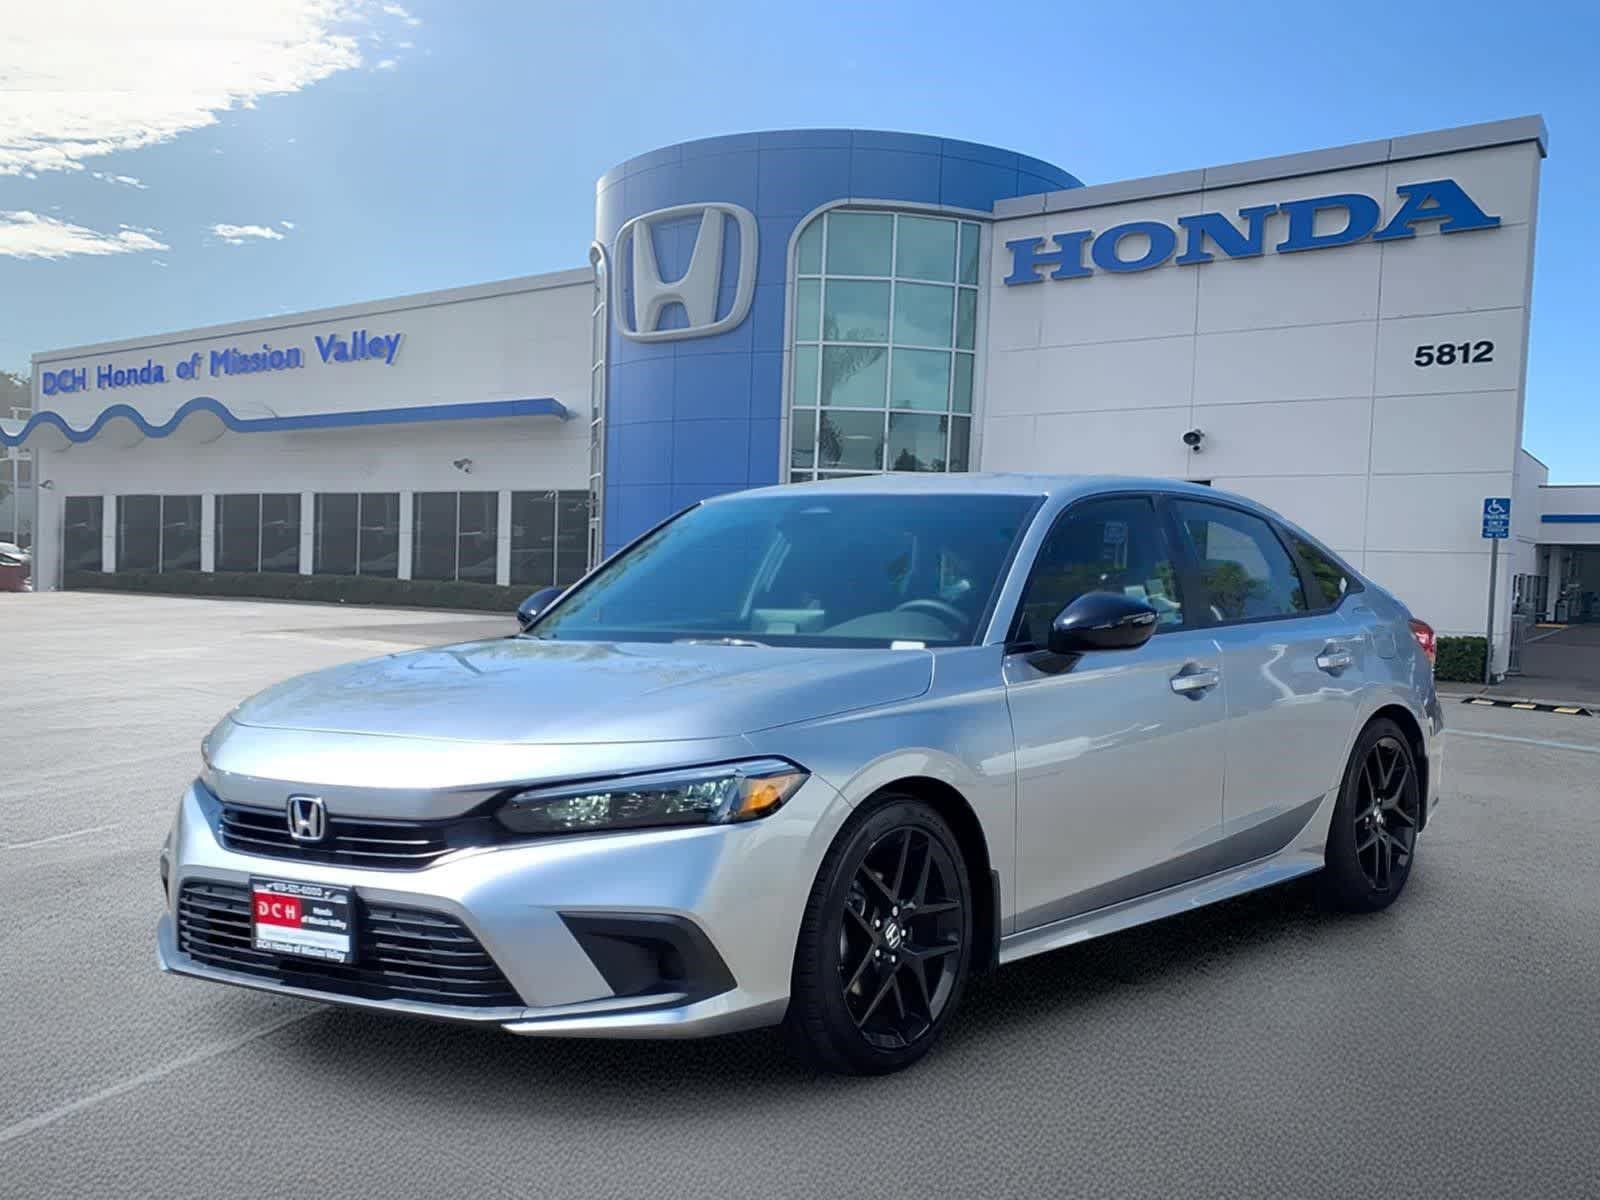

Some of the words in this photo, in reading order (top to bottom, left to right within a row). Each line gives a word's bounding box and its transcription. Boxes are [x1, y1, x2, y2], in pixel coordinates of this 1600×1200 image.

[1003, 179, 1501, 285] HONDA
[42, 368, 87, 396] DCH
[96, 361, 166, 389] Honda
[175, 352, 200, 380] of
[210, 344, 303, 377] Mission
[314, 329, 401, 365] Valley
[1414, 340, 1494, 367] 5812
[257, 900, 297, 920] DCH
